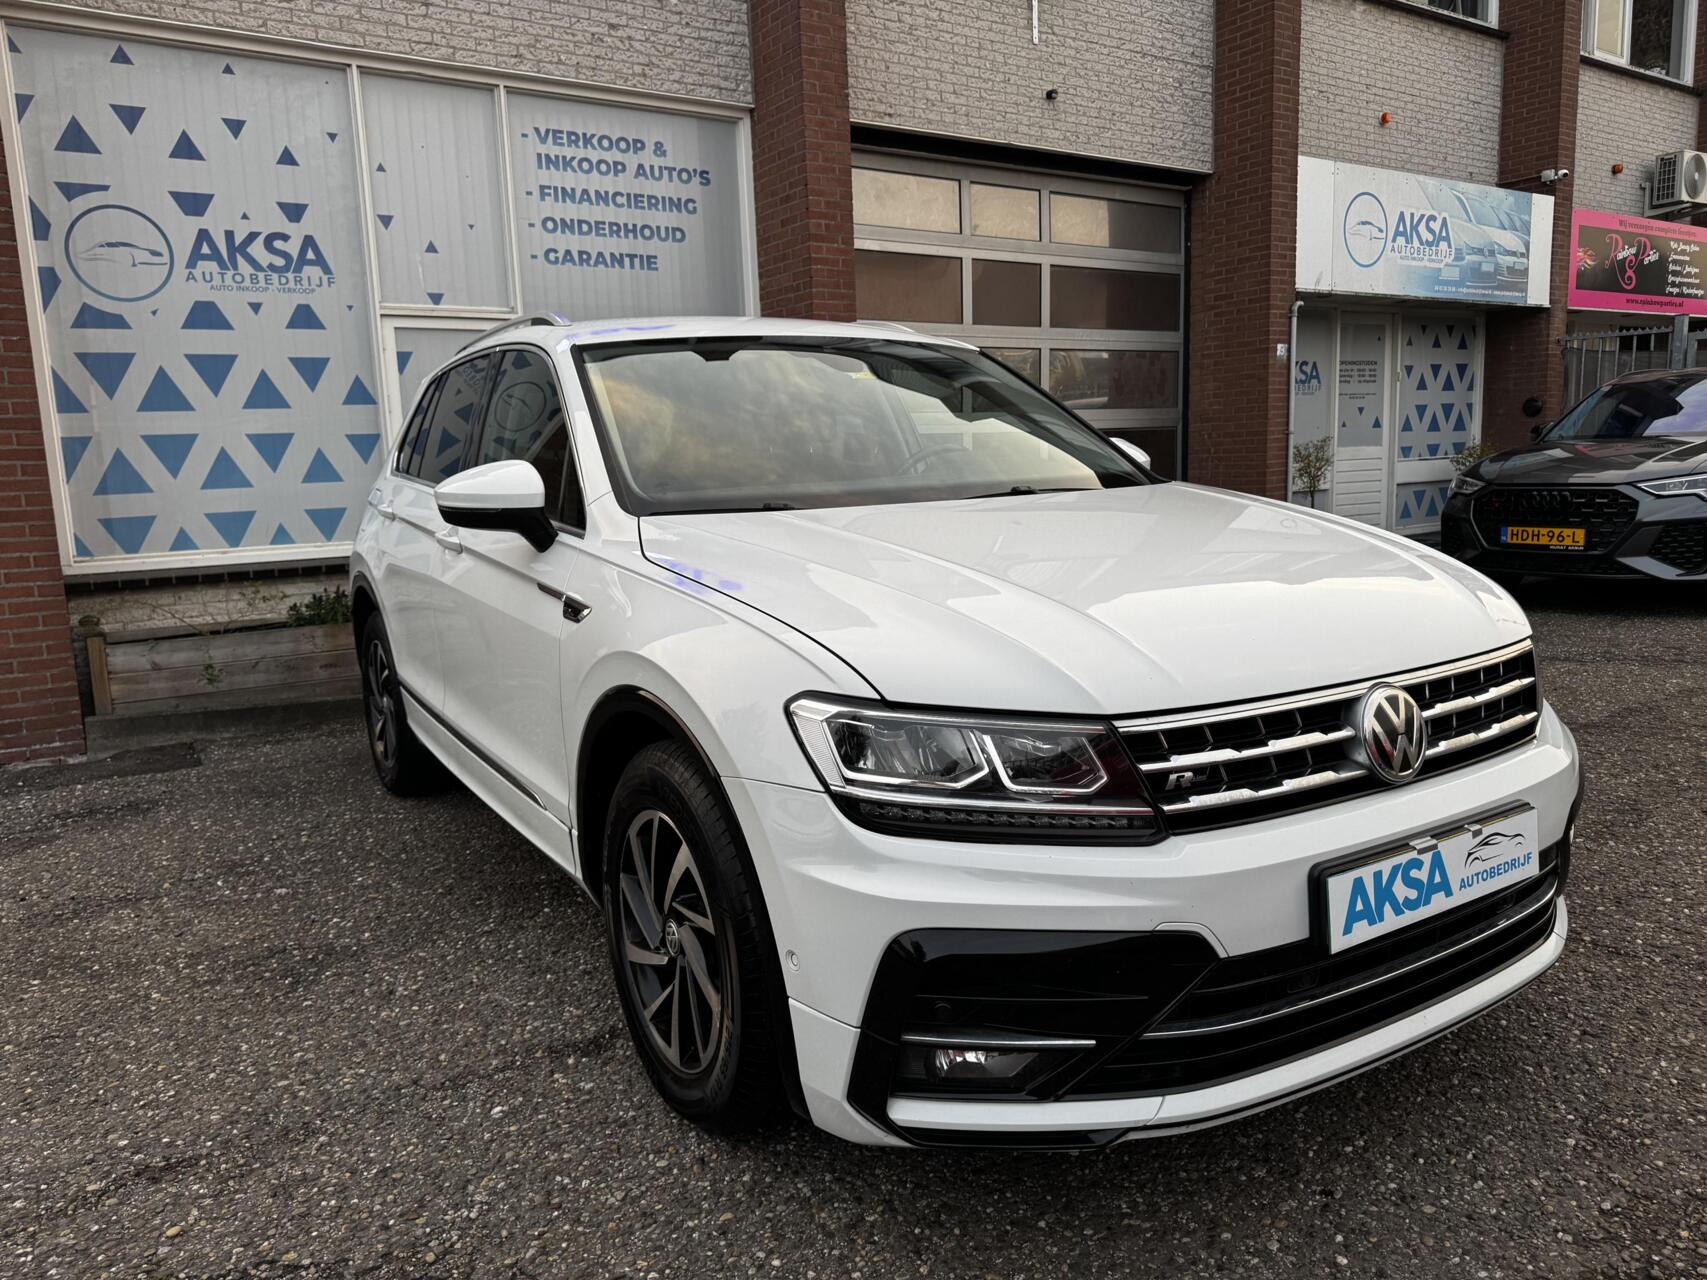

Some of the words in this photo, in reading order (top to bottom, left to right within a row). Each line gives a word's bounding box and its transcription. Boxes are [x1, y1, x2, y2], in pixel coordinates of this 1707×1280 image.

[533, 127, 646, 155] VERKOOP
[653, 141, 667, 158] &
[536, 152, 627, 177] INKOOP
[633, 163, 712, 187] AUTO'S
[538, 184, 698, 215] FINANCIERING
[541, 216, 687, 243] ONDERHOUD
[1391, 210, 1453, 249] AKSA
[184, 228, 334, 276] AKSA
[543, 247, 659, 272] GARANTIE
[1390, 244, 1453, 259] AUTOBEDRIJF
[185, 270, 336, 288] AUTOBEDRIJF
[209, 284, 234, 292] AUTO
[236, 285, 270, 293] INKOOP
[277, 286, 316, 295] VERKOOP
[1510, 529, 1580, 544] HDH-96-L
[1342, 849, 1454, 937] AKSA
[1458, 852, 1533, 892] AUTOBEDRIJF
